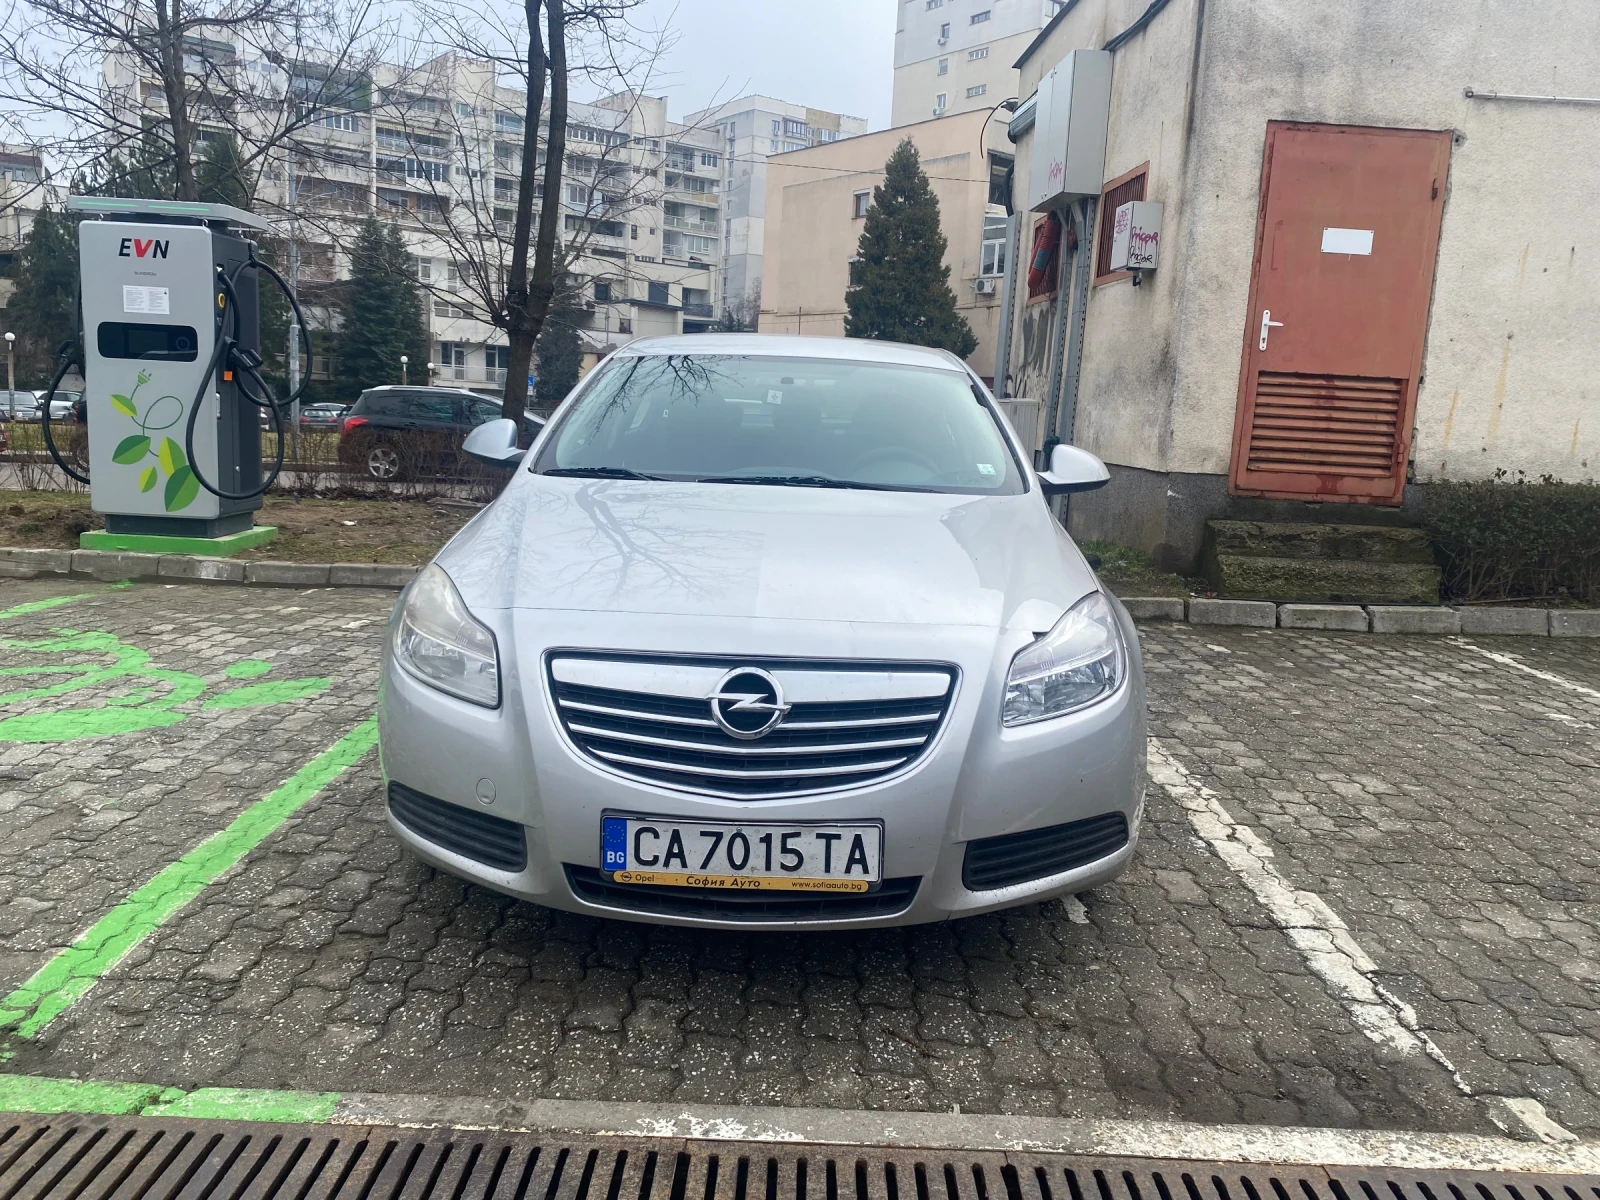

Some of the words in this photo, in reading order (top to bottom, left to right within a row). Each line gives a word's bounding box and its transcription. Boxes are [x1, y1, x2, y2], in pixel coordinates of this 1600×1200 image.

[118, 237, 170, 259] EVN
[633, 826, 688, 868] CA
[699, 830, 804, 872] 7015
[816, 833, 870, 874] TA
[606, 851, 625, 863] BG
[635, 873, 655, 883] Opel
[686, 876, 726, 887] София
[730, 878, 761, 888] Ауто
[791, 881, 862, 891] www.sofiaauto.bg
